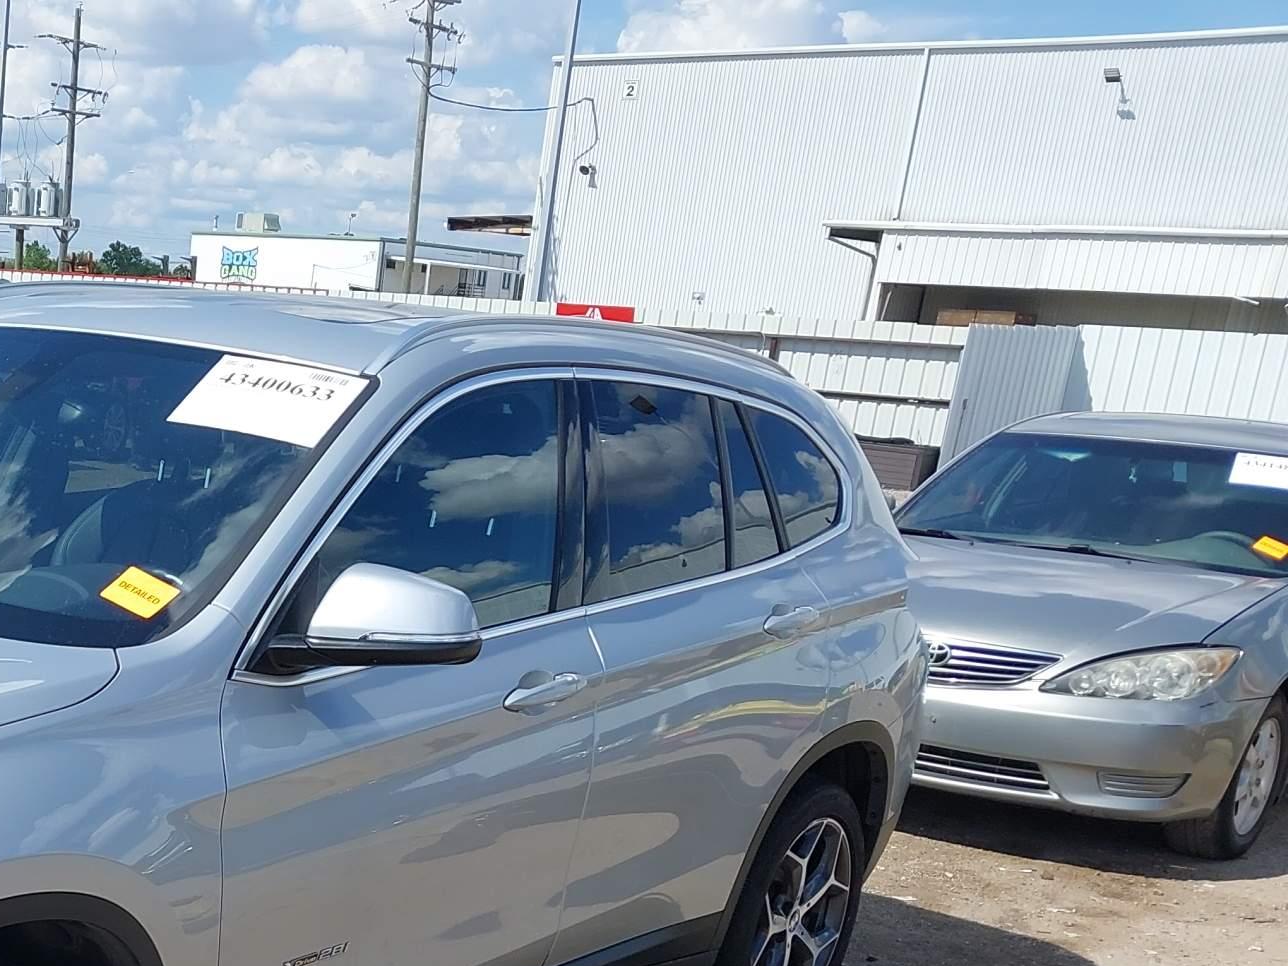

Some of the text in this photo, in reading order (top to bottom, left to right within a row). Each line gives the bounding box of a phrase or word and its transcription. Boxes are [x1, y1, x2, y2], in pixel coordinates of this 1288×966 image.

[625, 84, 635, 97] 2
[221, 245, 258, 266] BOX
[220, 264, 257, 280] GANG
[219, 371, 336, 402] 43400633
[118, 580, 161, 605] DETAILED
